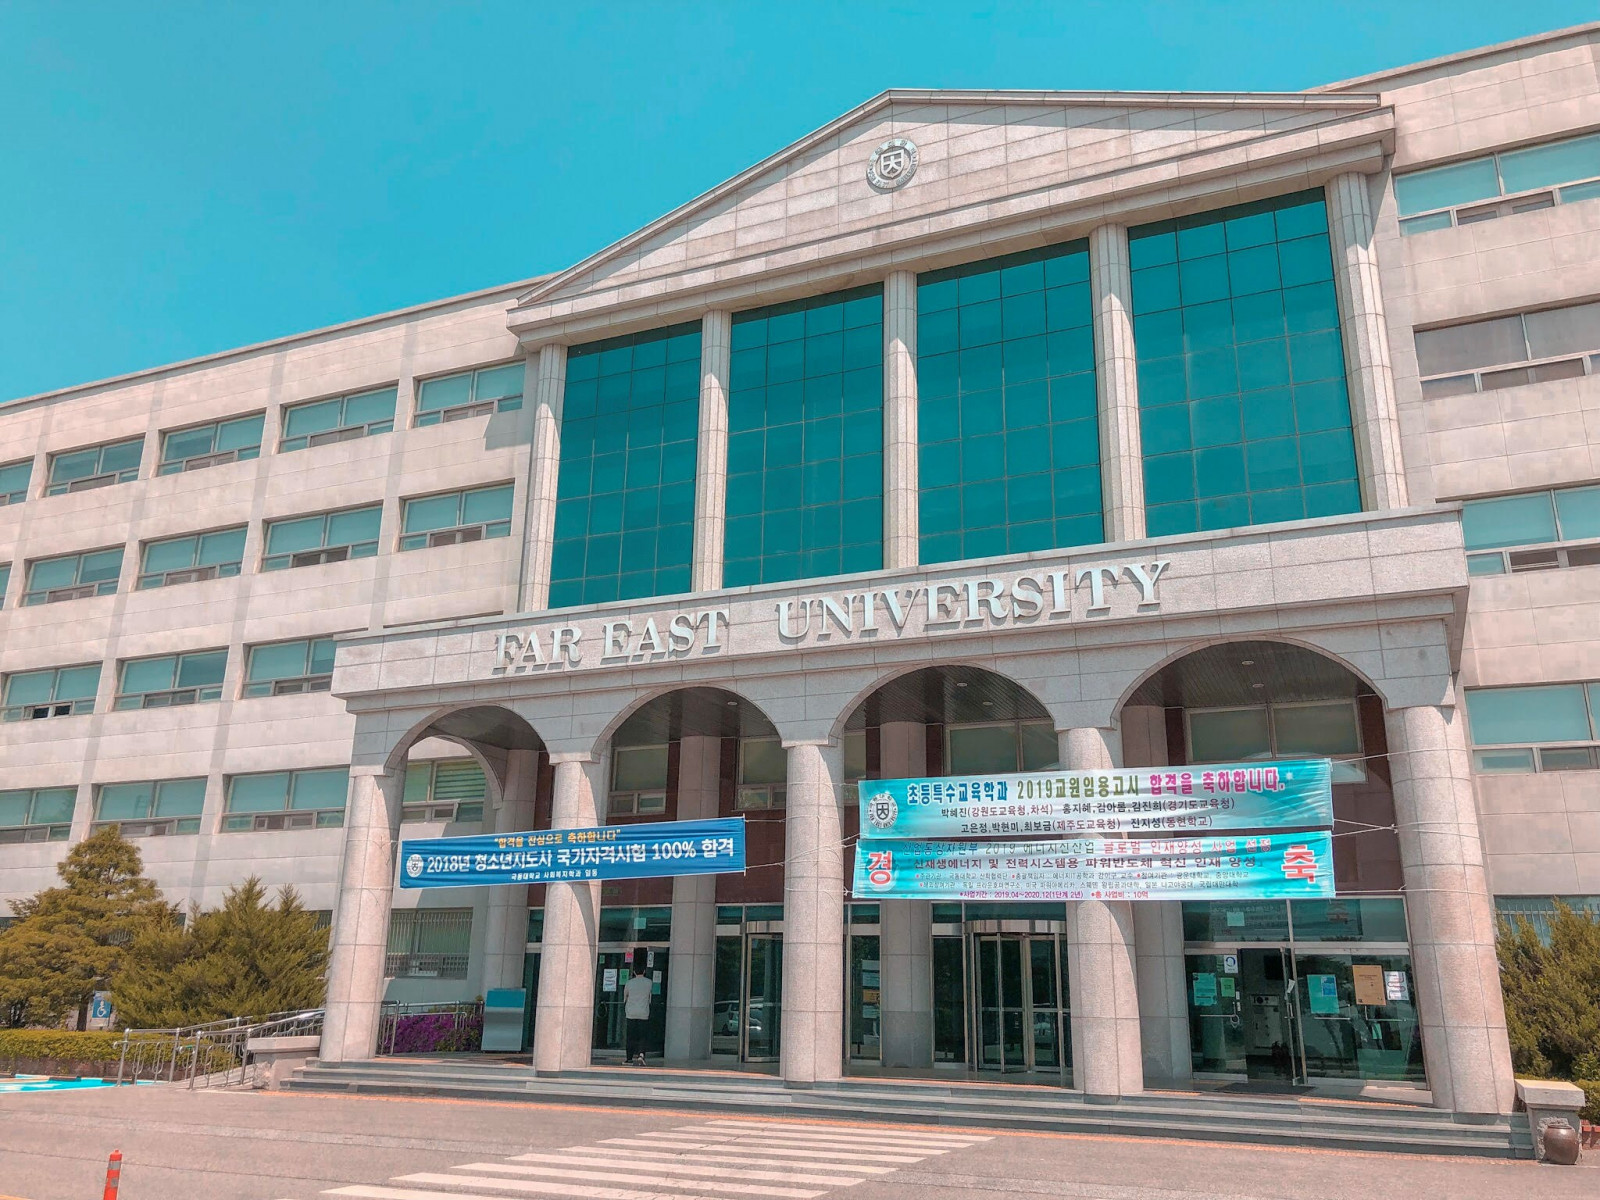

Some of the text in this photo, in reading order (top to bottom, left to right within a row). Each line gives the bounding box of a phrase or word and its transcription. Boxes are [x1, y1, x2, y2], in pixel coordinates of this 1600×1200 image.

[493, 560, 1171, 672] FAR EAST UNIVERSITY
[907, 767, 1286, 805] 초등특수교육학과 2019교원임용고시 합격을 축하합니다.
[528, 833, 563, 846] 진심으로
[986, 843, 1016, 855] 2019
[1023, 842, 1094, 855] 에너지신산업
[1104, 840, 1141, 854] 글로벌
[1151, 840, 1202, 854] 인재양성
[1212, 840, 1237, 854] 사업
[427, 854, 470, 873] 2018년
[474, 849, 552, 871] 청소년지도사
[557, 843, 646, 867] 국가자격시험
[651, 840, 697, 860] 100%
[701, 837, 734, 858] 합격
[914, 858, 982, 869] 신재생에너지
[989, 858, 998, 869] 및
[1006, 858, 1079, 869] 전력시스템용
[1085, 857, 1153, 868] 파워반도체
[1160, 857, 1187, 868] 혁신
[1195, 857, 1221, 868] 인재
[1282, 845, 1317, 883] 축
[543, 870, 581, 879] 사회복지학과
[868, 851, 892, 885] 경
[964, 891, 988, 899] 사업기간
[1104, 890, 1125, 899] 사업비
[1133, 890, 1149, 898] 10억
